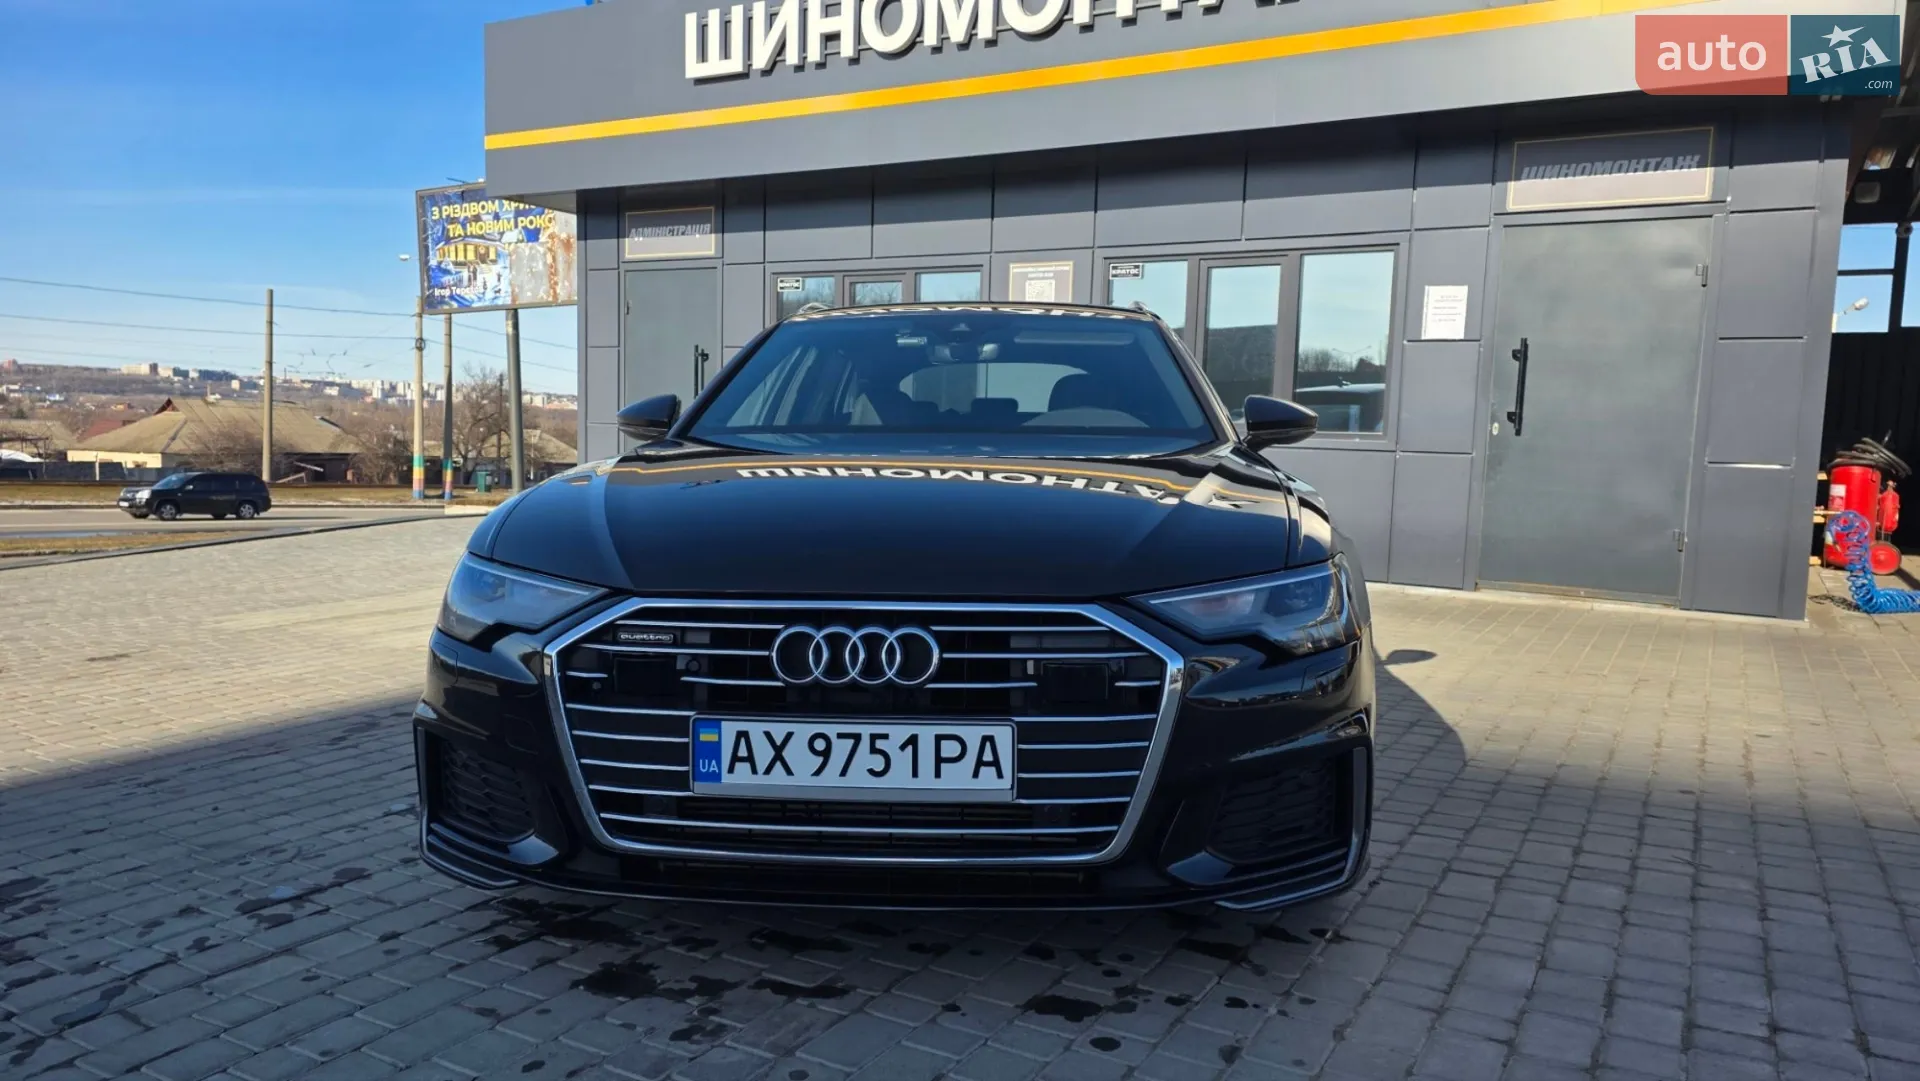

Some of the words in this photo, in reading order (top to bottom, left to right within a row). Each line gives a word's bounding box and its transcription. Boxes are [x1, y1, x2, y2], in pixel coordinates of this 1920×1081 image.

[1520, 154, 1701, 181] ШИНОМОНТАЖ
[431, 206, 440, 220] З
[442, 199, 499, 218] РІЗДВОМ
[447, 222, 464, 237] ТА
[466, 217, 515, 236] НОВИМ
[629, 223, 711, 240] АДМІНІСТРАЦІЯ
[620, 633, 671, 642] quattro
[727, 730, 794, 776] AX
[807, 732, 919, 778] 9751
[934, 734, 1004, 779] PA
[700, 759, 718, 773] UA
